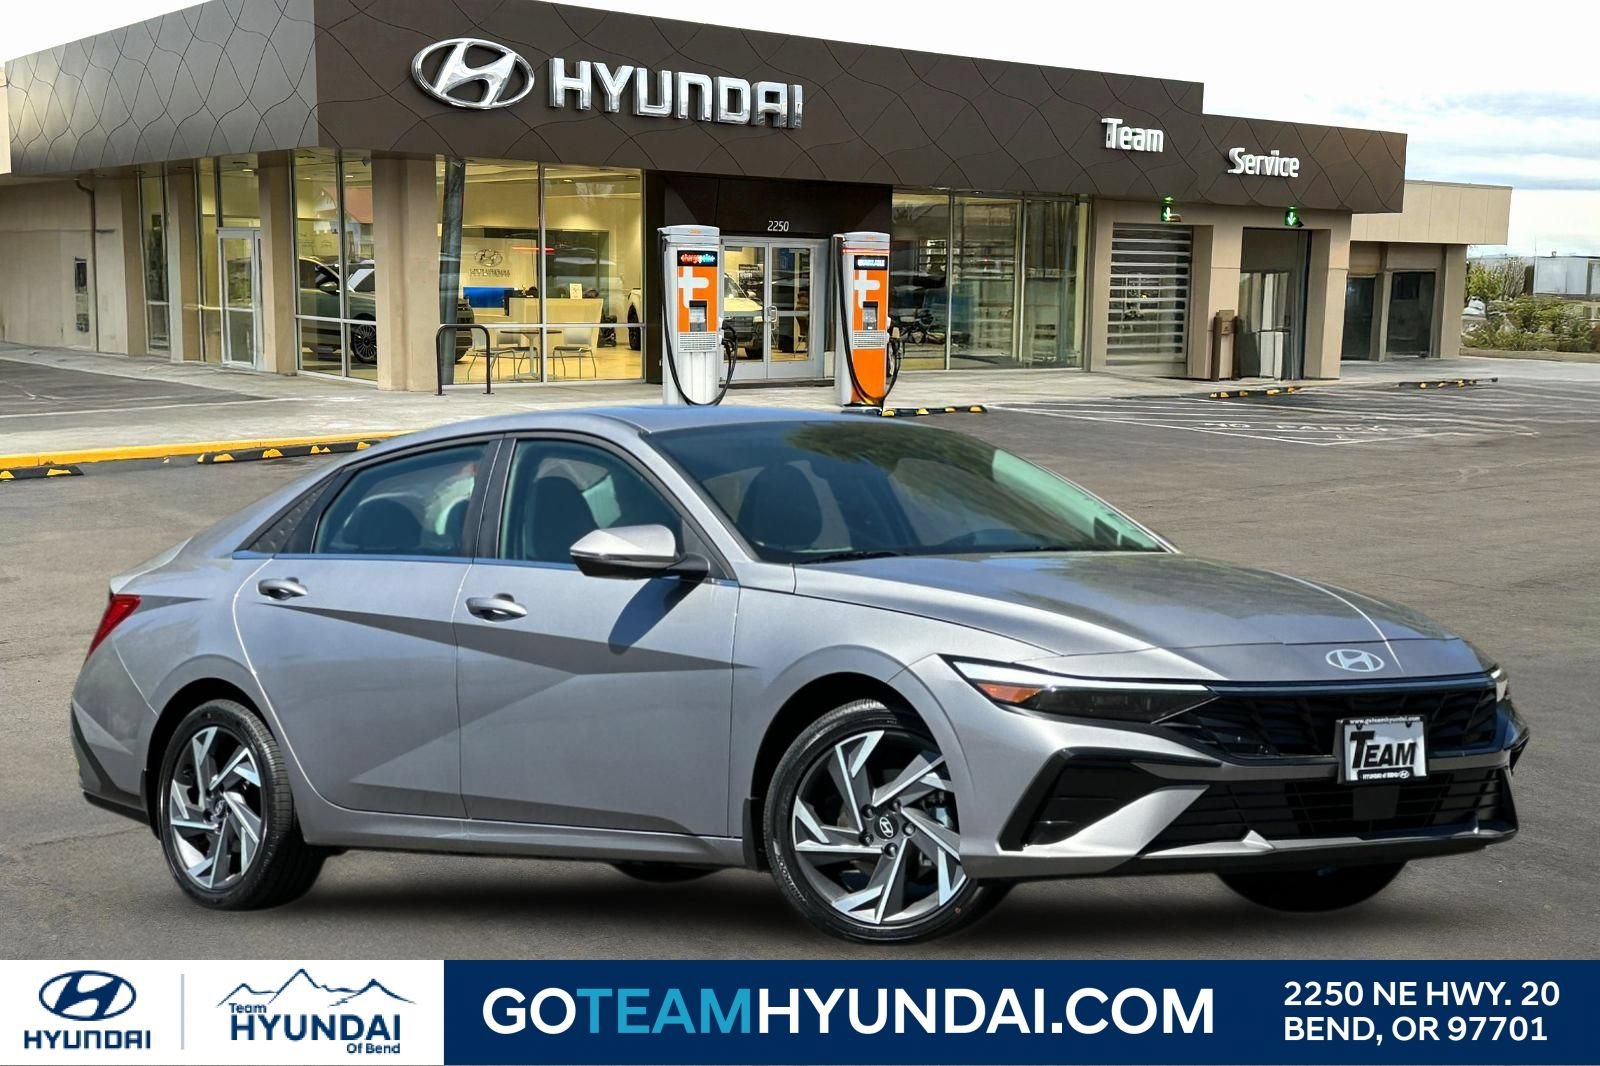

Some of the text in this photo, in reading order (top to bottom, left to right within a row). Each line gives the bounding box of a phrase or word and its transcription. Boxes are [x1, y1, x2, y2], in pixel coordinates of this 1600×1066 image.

[549, 57, 803, 129] HYUNDAI
[1101, 117, 1164, 152] Team
[1227, 147, 1300, 177] Service
[767, 220, 790, 232] 2250
